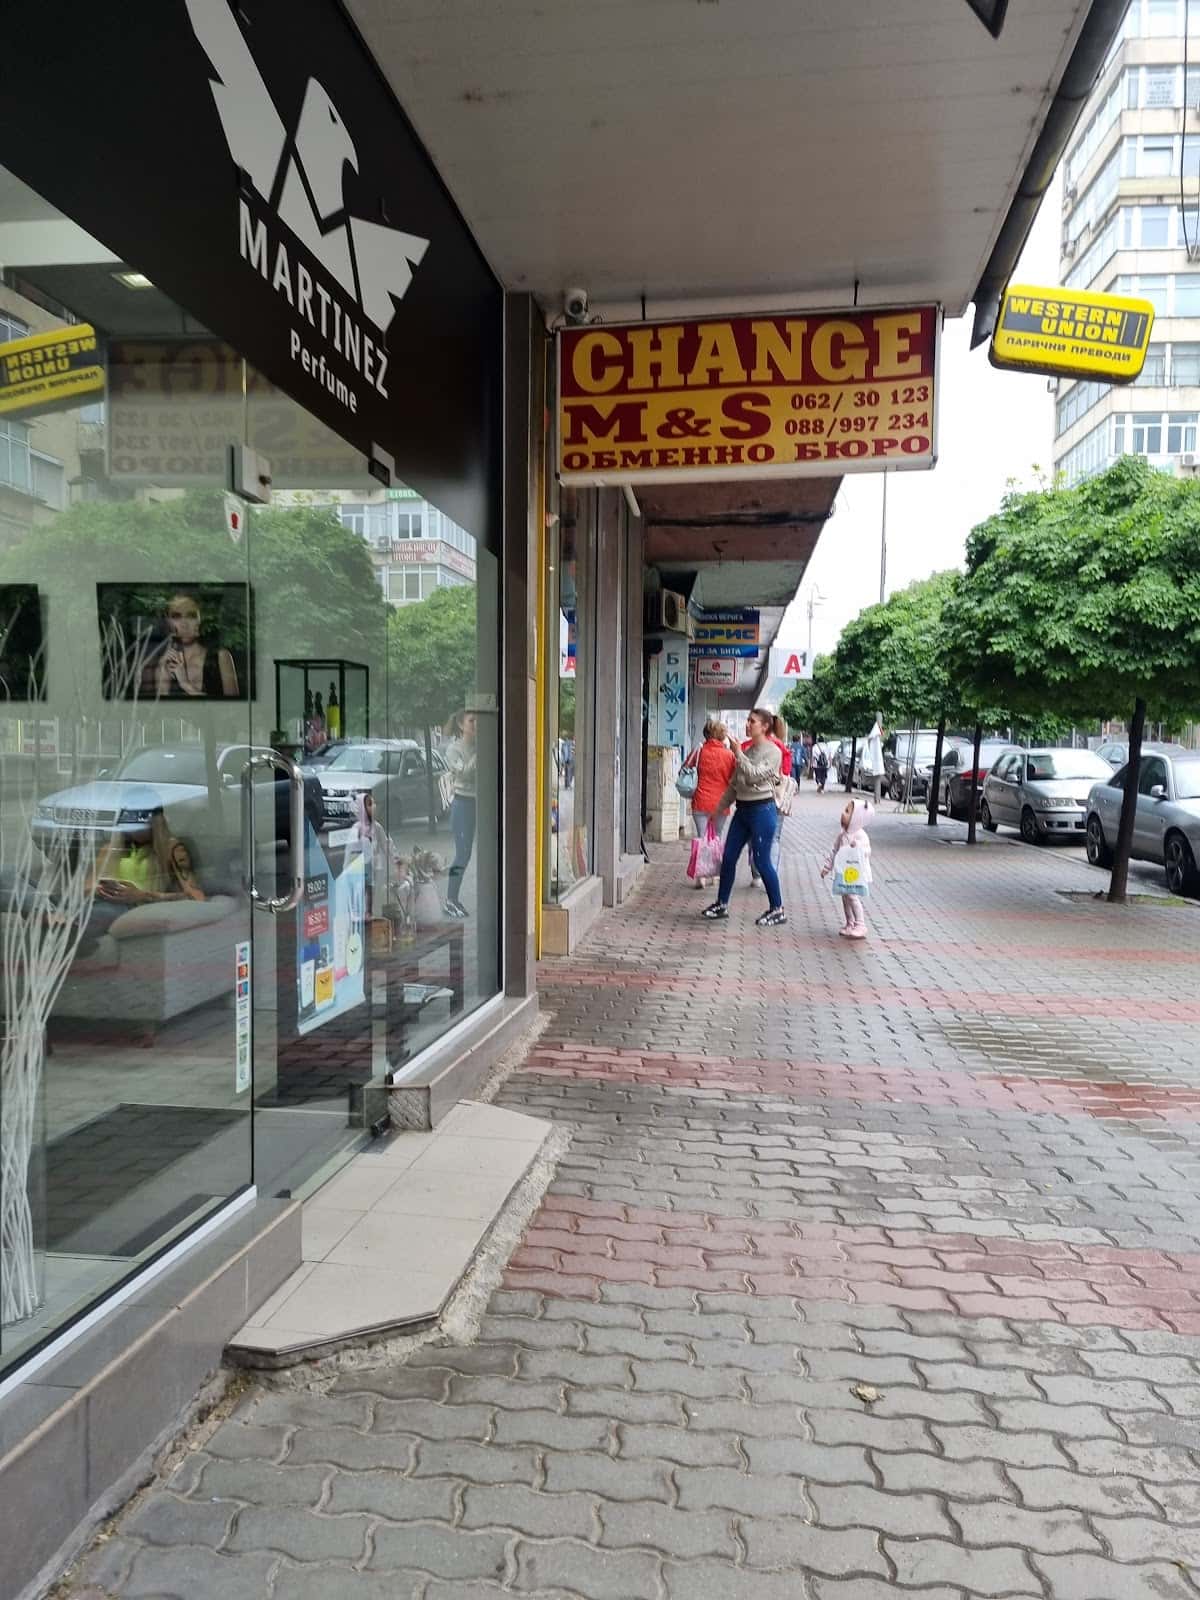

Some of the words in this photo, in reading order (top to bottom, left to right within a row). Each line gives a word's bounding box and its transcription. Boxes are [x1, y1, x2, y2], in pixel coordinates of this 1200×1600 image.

[239, 198, 390, 400] MARTINEZ
[1009, 297, 1123, 326] WESTERN
[1041, 317, 1120, 344] UNION
[572, 312, 923, 394] CHANGE
[1005, 336, 1067, 352] ПАРИЧНИ
[1070, 344, 1131, 362] ПРЕВОДИ
[290, 327, 359, 415] Perfume
[790, 390, 844, 413] 062/
[853, 390, 881, 409] 30
[890, 385, 930, 404] 123
[785, 416, 879, 439] 088/997
[888, 412, 930, 431] 234
[563, 444, 777, 470] ОБМЕННО
[794, 434, 931, 461] БЮРО
[783, 651, 808, 675] A1
[665, 652, 681, 747] БИЖУТ
